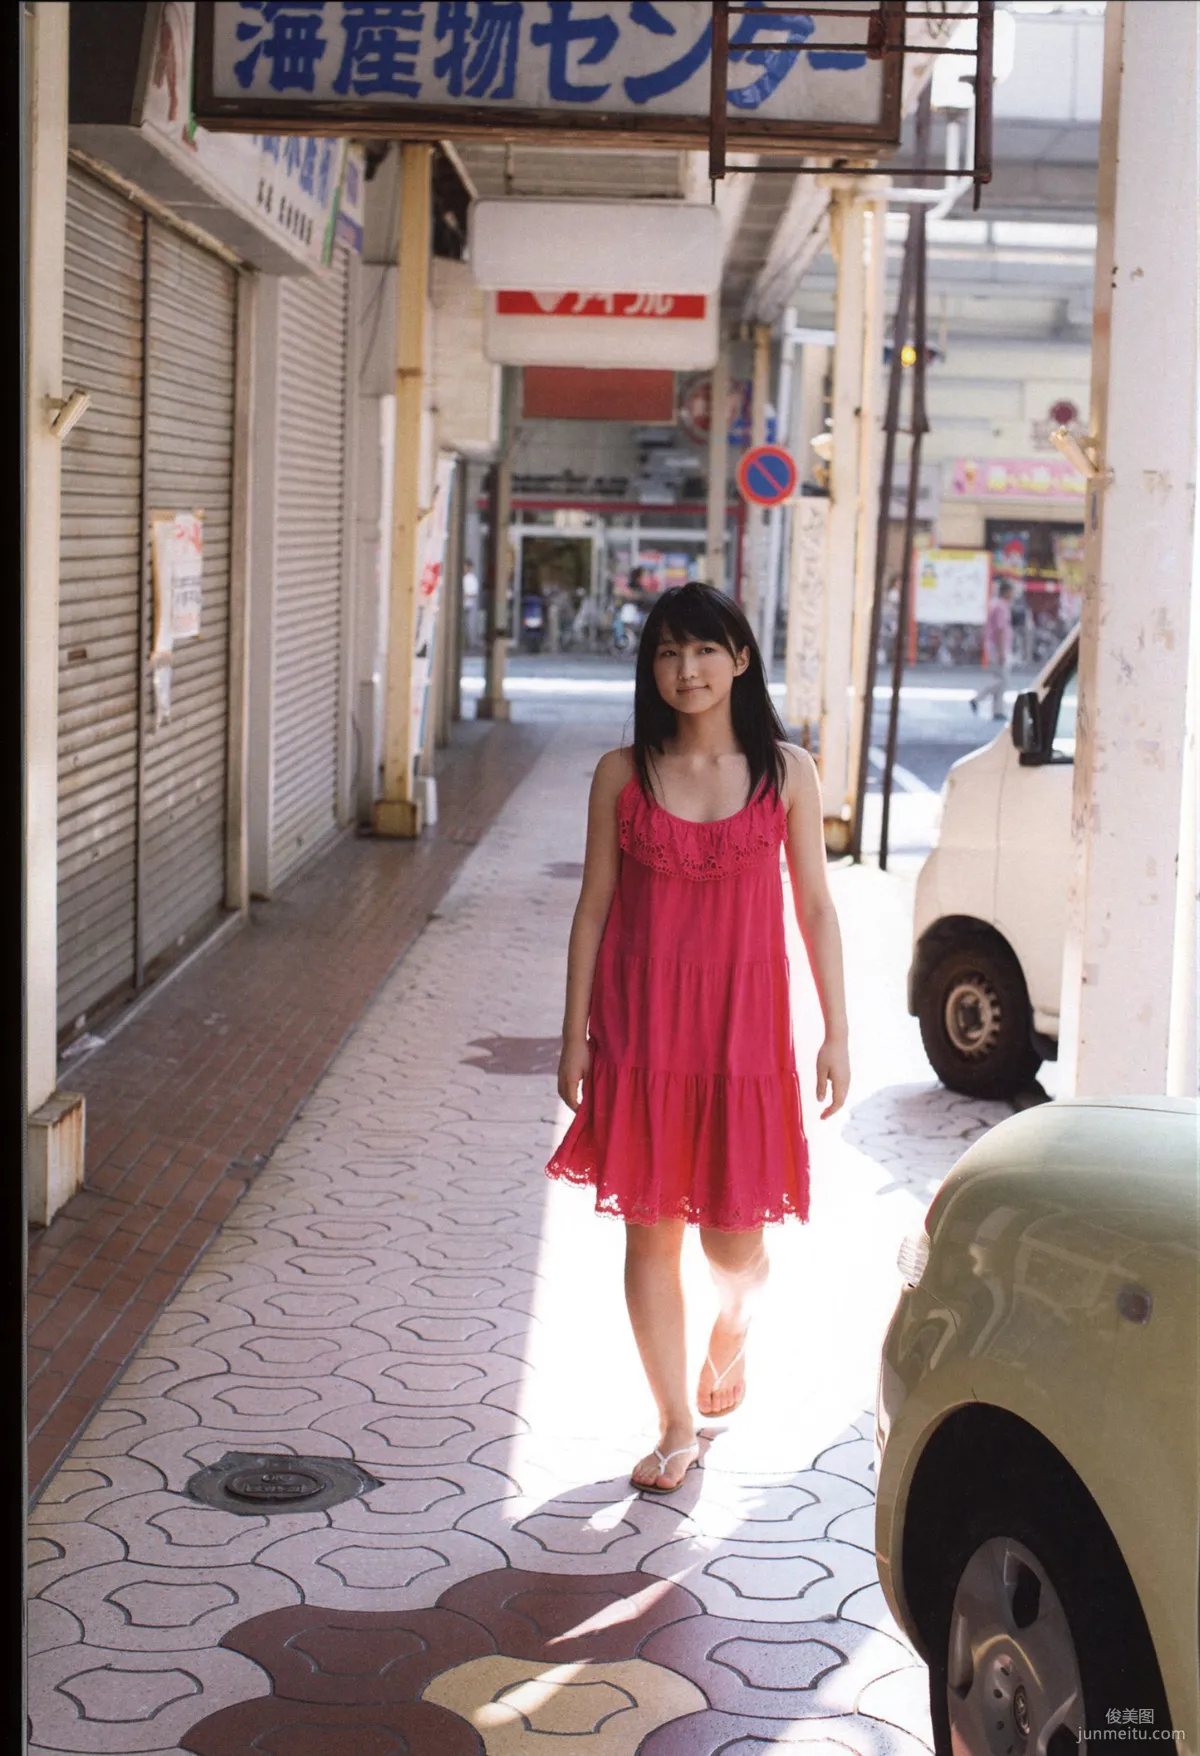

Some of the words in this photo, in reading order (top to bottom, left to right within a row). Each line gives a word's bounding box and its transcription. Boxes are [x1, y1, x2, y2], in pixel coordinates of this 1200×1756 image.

[234, 2, 867, 109] 海産物センター
